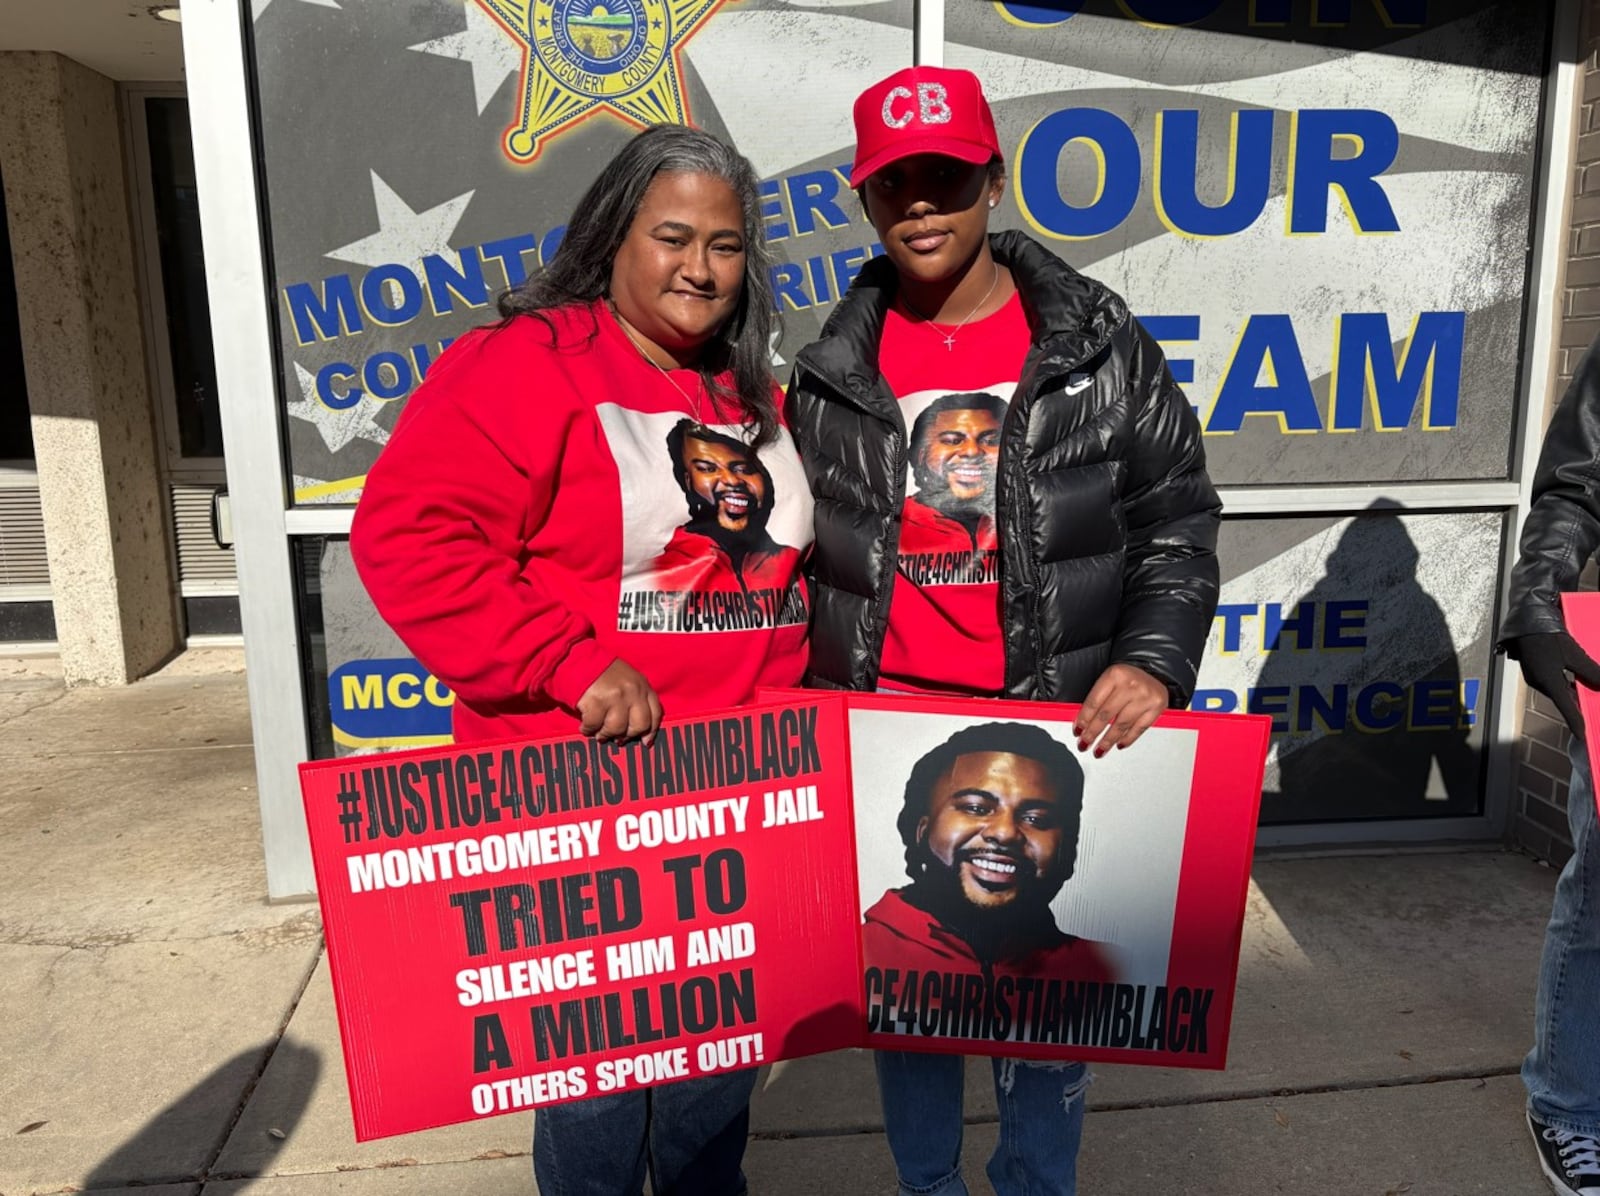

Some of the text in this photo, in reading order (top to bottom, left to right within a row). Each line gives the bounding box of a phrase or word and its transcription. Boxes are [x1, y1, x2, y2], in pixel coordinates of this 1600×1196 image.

[539, 36, 662, 93] MONTGOMERY COUNTY
[552, 9, 585, 68] THE GREAT
[620, 44, 642, 67] OHIO
[881, 82, 952, 129] CB
[1013, 107, 1401, 240] OUR
[1212, 600, 1369, 657] THE
[336, 705, 823, 844] #JUSTICE4CHRISTIANMBLACK
[346, 785, 824, 893] MONTGOMERY COUNTY JAIL
[449, 848, 747, 957] TRIED TO
[455, 921, 756, 1007] SILENCE HIM AND
[472, 968, 758, 1075] A MILLION
[471, 1032, 765, 1116] OTHERS SPOKE OUT!
